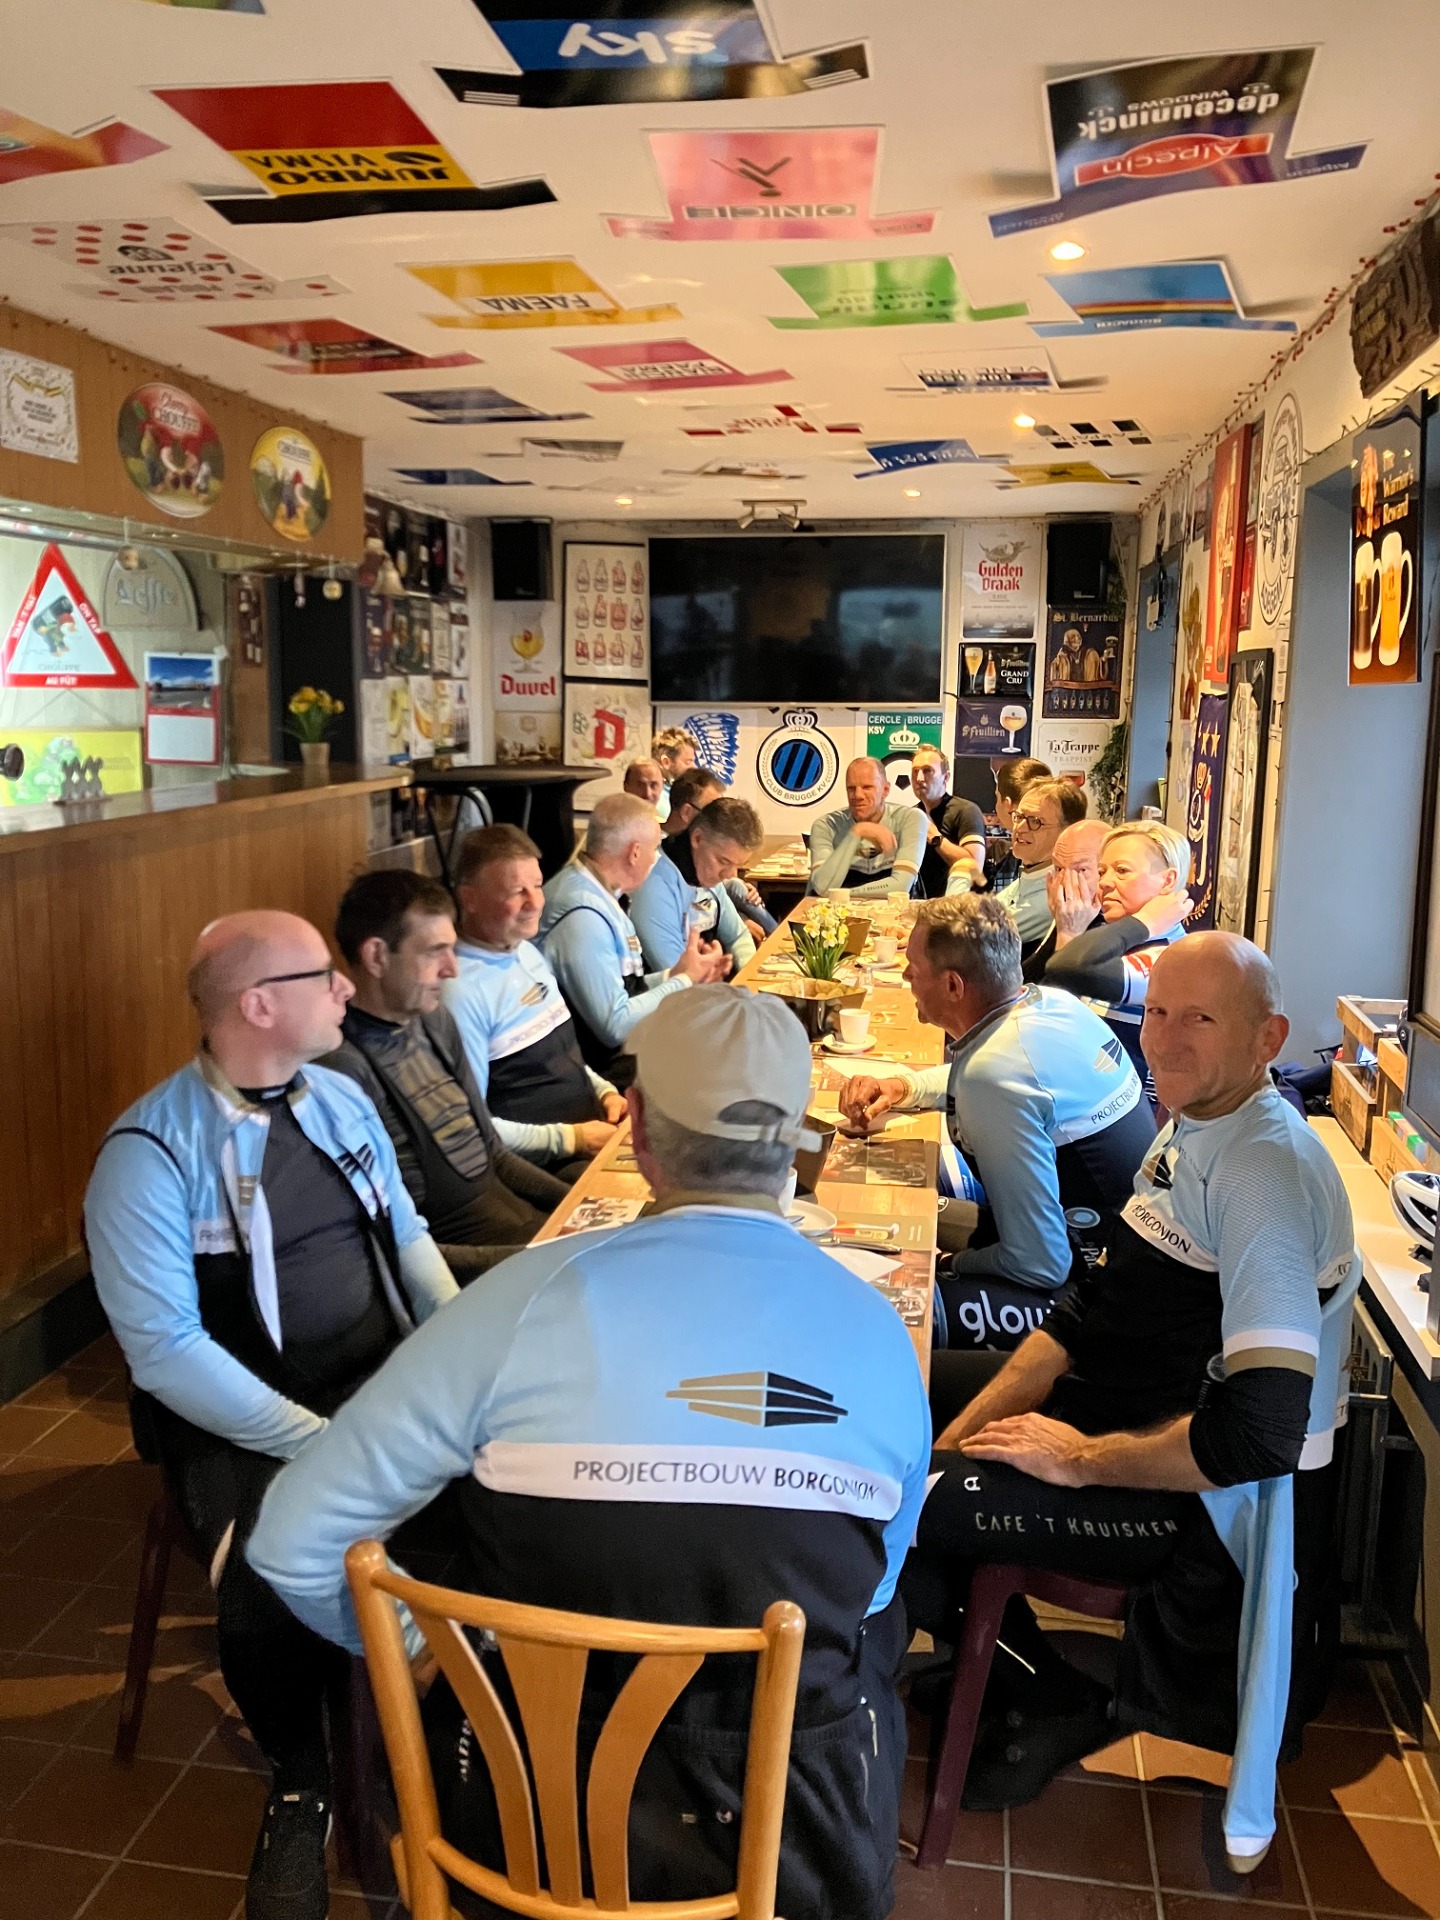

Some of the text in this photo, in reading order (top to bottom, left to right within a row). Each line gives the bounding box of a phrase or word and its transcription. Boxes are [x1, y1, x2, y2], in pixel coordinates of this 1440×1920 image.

[558, 22, 717, 64] sky
[1127, 88, 1230, 112] WINDOWS
[1079, 93, 1280, 141] deceuninck
[246, 152, 375, 169] VISMA
[1102, 142, 1241, 175] Alpecin
[268, 166, 450, 186] JUMBO
[106, 261, 236, 277] Lejeune
[477, 294, 591, 311] FAEMA
[978, 559, 1024, 578] Gulden
[982, 577, 1020, 591] Draak
[1000, 670, 1029, 678] GRAND
[1006, 677, 1023, 685] CRU
[500, 673, 556, 696] Duvel
[868, 715, 942, 725] CERCLE BRUGGE
[868, 726, 885, 735] KSV
[1060, 739, 1100, 755] Trappe
[766, 778, 828, 801] CLUB BRUGGE KV
[573, 1460, 768, 1485] PROJECTBOUW
[975, 1512, 1026, 1533] CAFE
[1068, 1518, 1178, 1537] KRUISKEN
